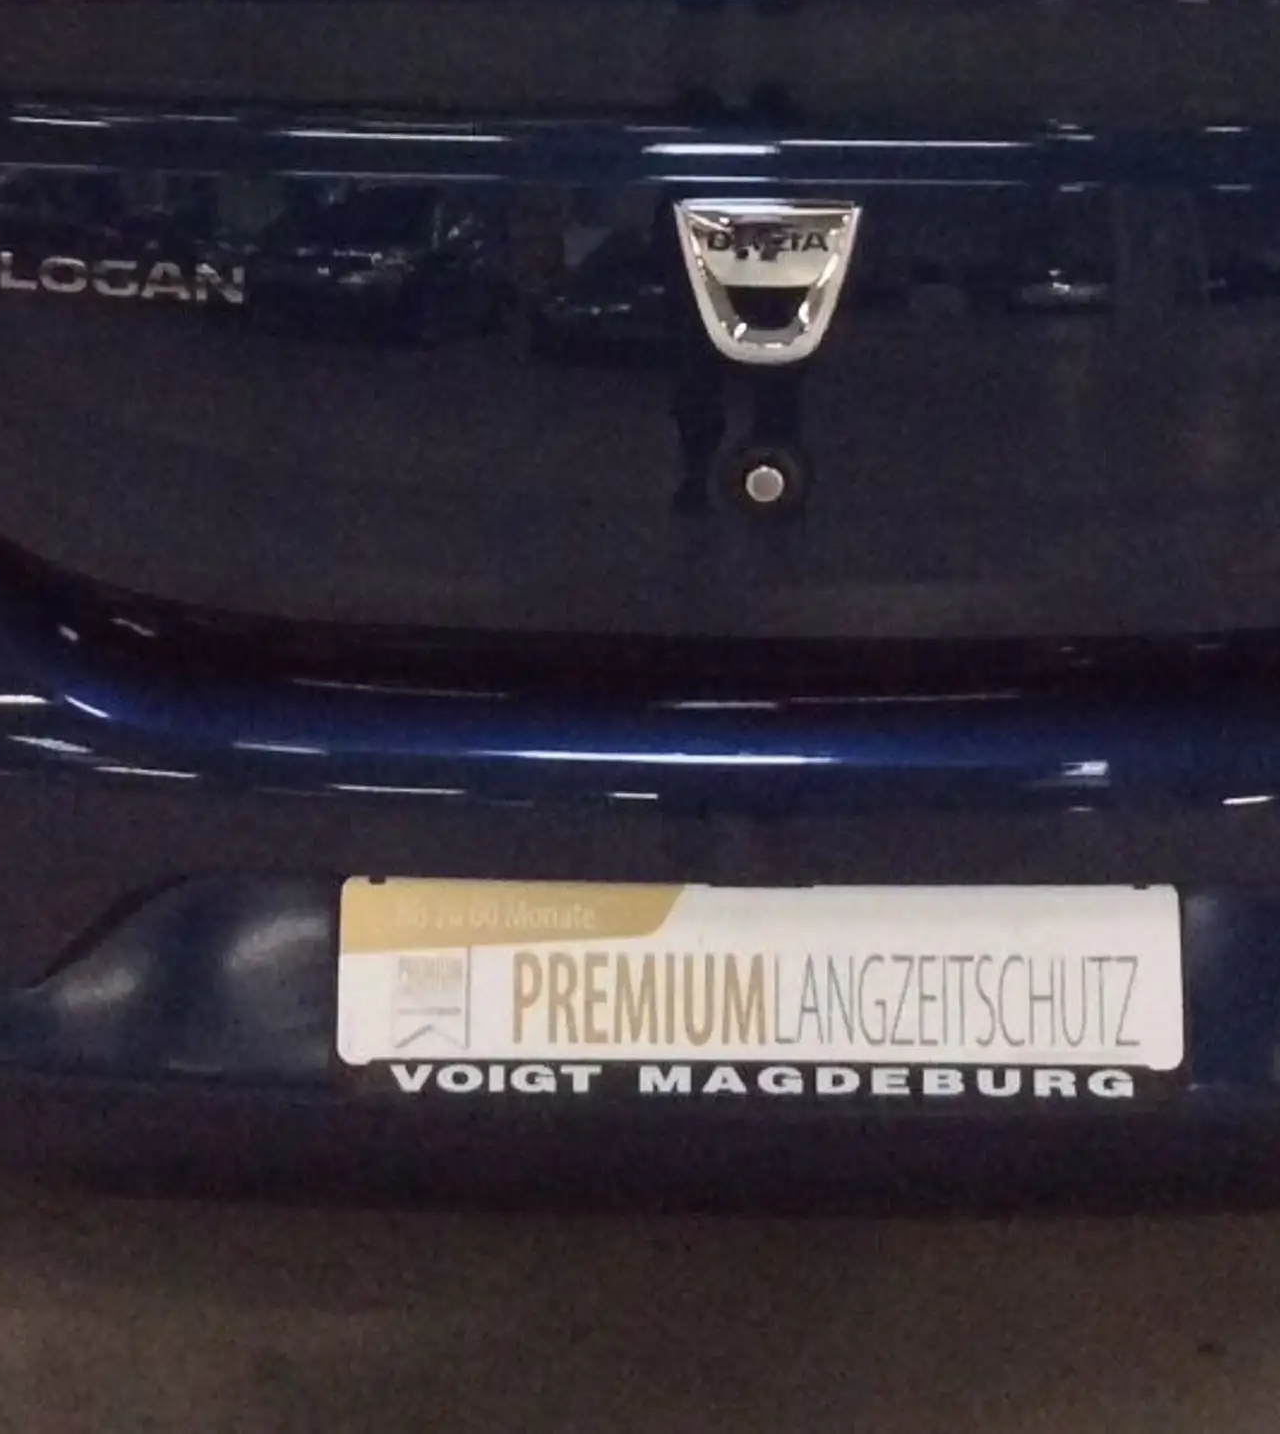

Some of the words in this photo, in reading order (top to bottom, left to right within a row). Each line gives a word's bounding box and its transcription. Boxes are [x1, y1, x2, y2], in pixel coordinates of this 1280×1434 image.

[0, 250, 245, 303] LOGAN
[390, 1064, 603, 1094] VOIGT
[640, 1065, 1134, 1098] MAGDEBURG
